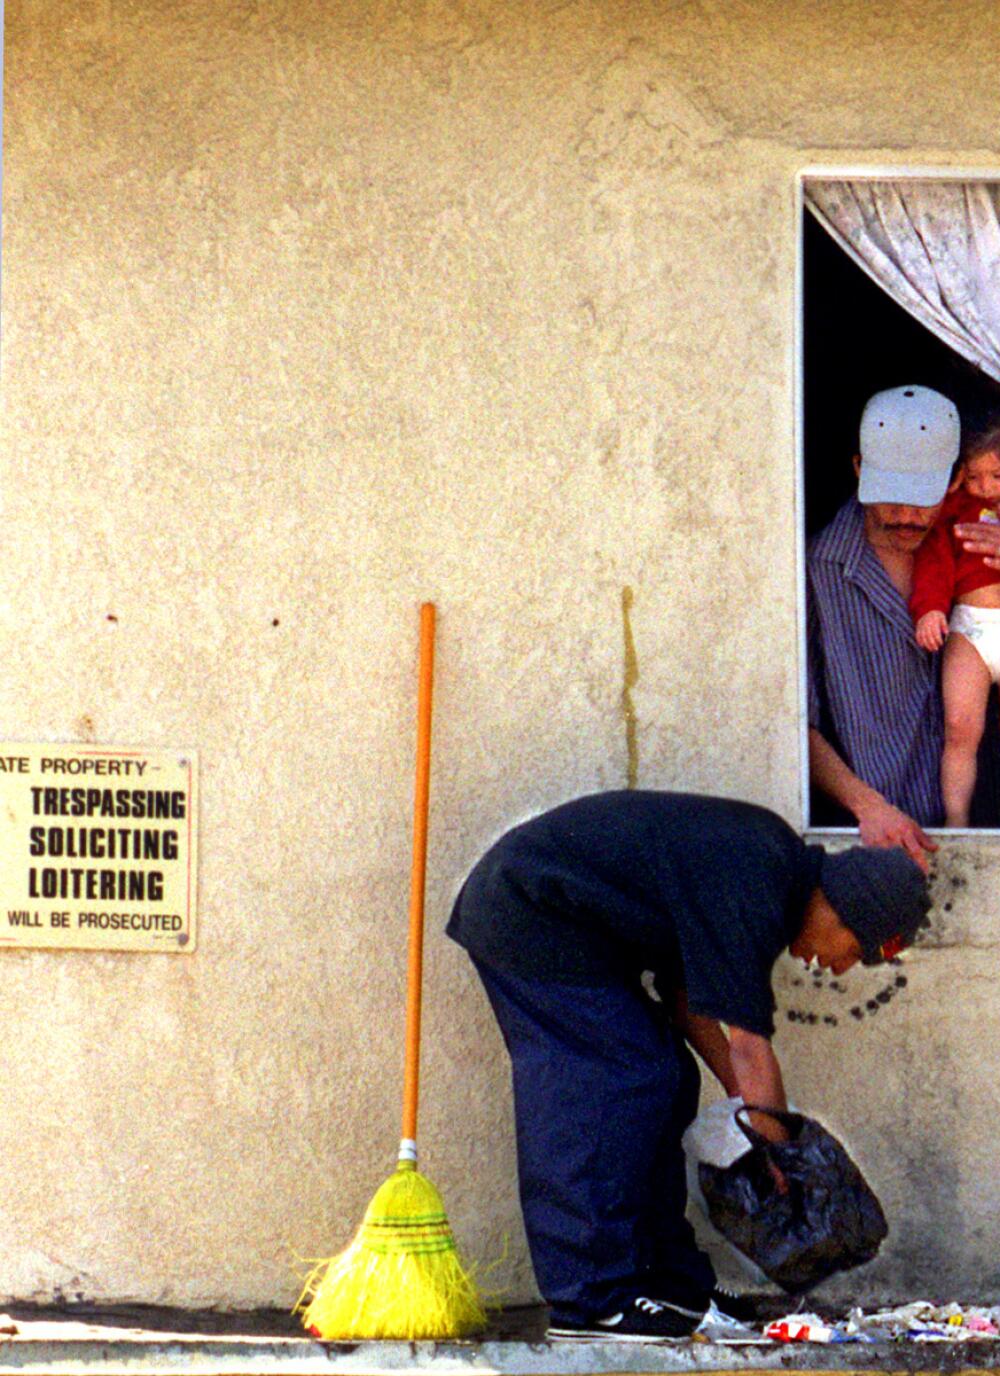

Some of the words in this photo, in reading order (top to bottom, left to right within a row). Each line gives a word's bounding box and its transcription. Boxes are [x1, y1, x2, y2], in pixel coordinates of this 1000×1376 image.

[41, 758, 148, 776] PROPERTY
[31, 787, 186, 819] TRESPASSING
[29, 827, 179, 860] SOLICITING
[28, 867, 164, 901] LOITERING
[8, 911, 43, 927] WILL
[51, 912, 70, 928] BE
[78, 913, 183, 931] PROSECUTED
